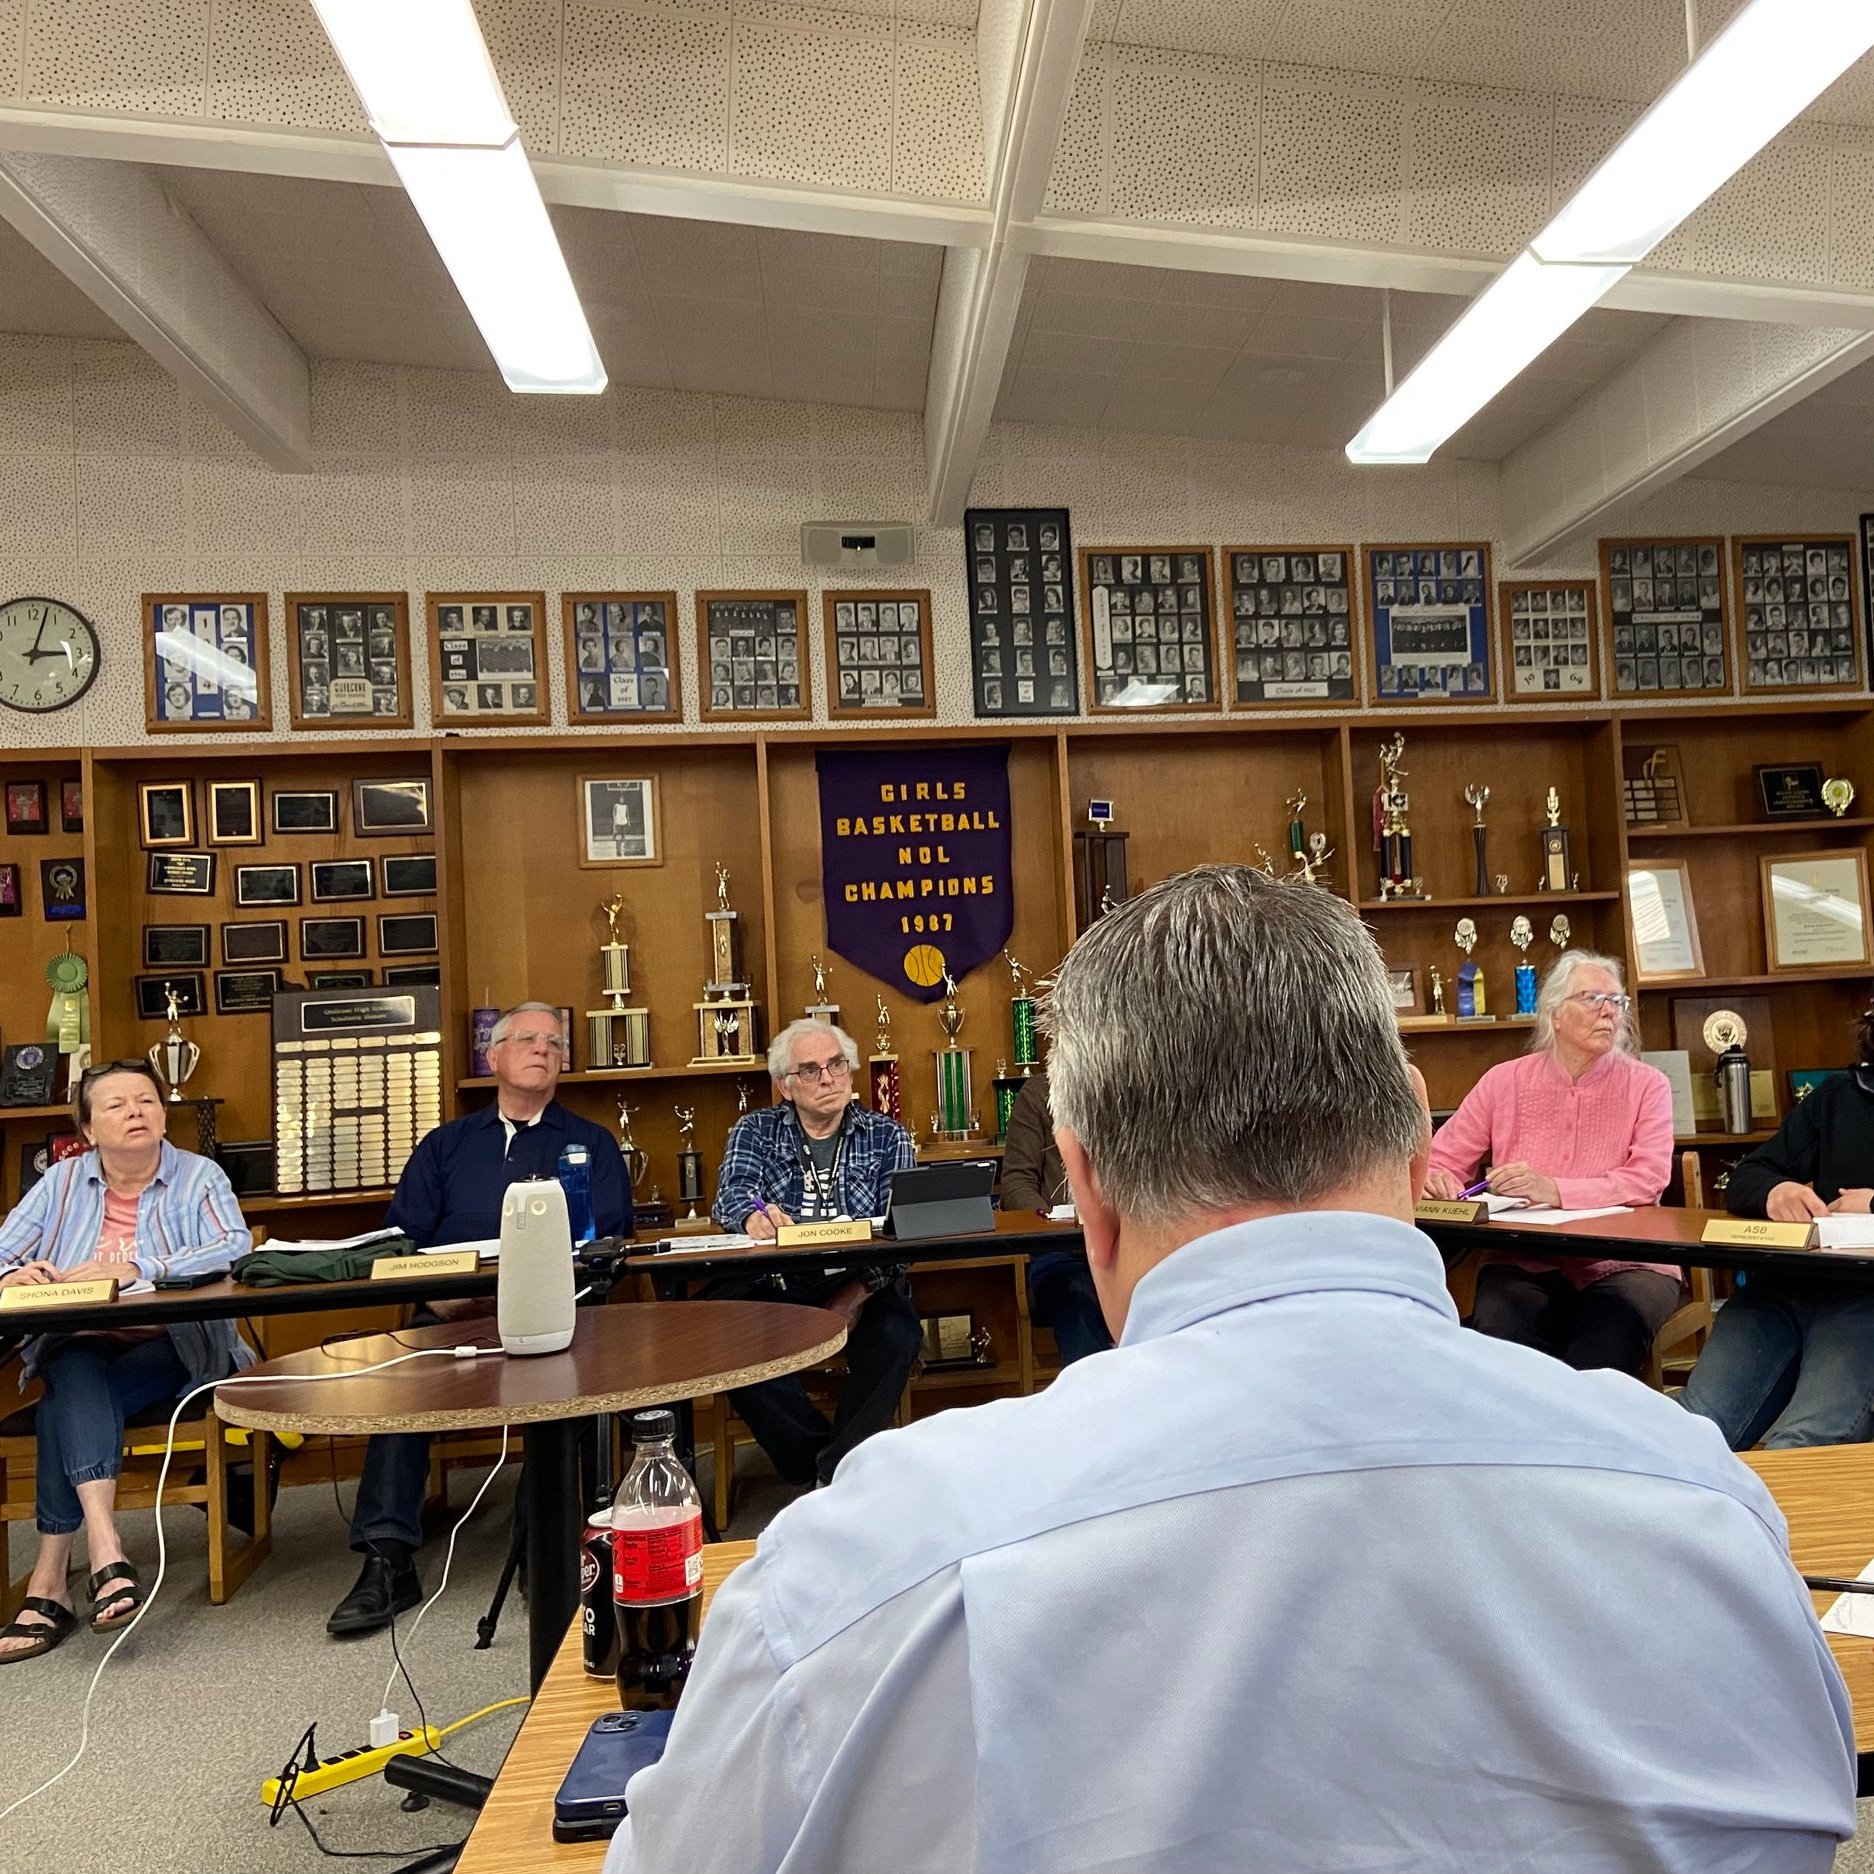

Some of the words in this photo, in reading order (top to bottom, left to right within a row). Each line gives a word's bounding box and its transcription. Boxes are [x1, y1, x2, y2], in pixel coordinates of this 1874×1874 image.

[28, 609, 38, 620] 12
[7, 615, 17, 627] 11
[69, 628, 76, 639] 2
[613, 675, 634, 684] Class
[56, 682, 63, 694] 5
[34, 689, 42, 701] 6
[881, 782, 966, 802] GIRLS
[836, 810, 1000, 836] BASKETBALL
[898, 846, 950, 864] NOL
[845, 875, 994, 902] CHAMPIONS
[901, 913, 953, 933] 1987
[1442, 1207, 1470, 1216] KUEHL
[798, 1230, 817, 1238] JON
[819, 1227, 853, 1236] COOKE
[1744, 1225, 1768, 1234] ASB
[390, 1263, 407, 1271] JIM
[409, 1259, 460, 1269] HODGSON
[19, 1289, 58, 1300] SHONA
[61, 1287, 94, 1297] DAVIS
